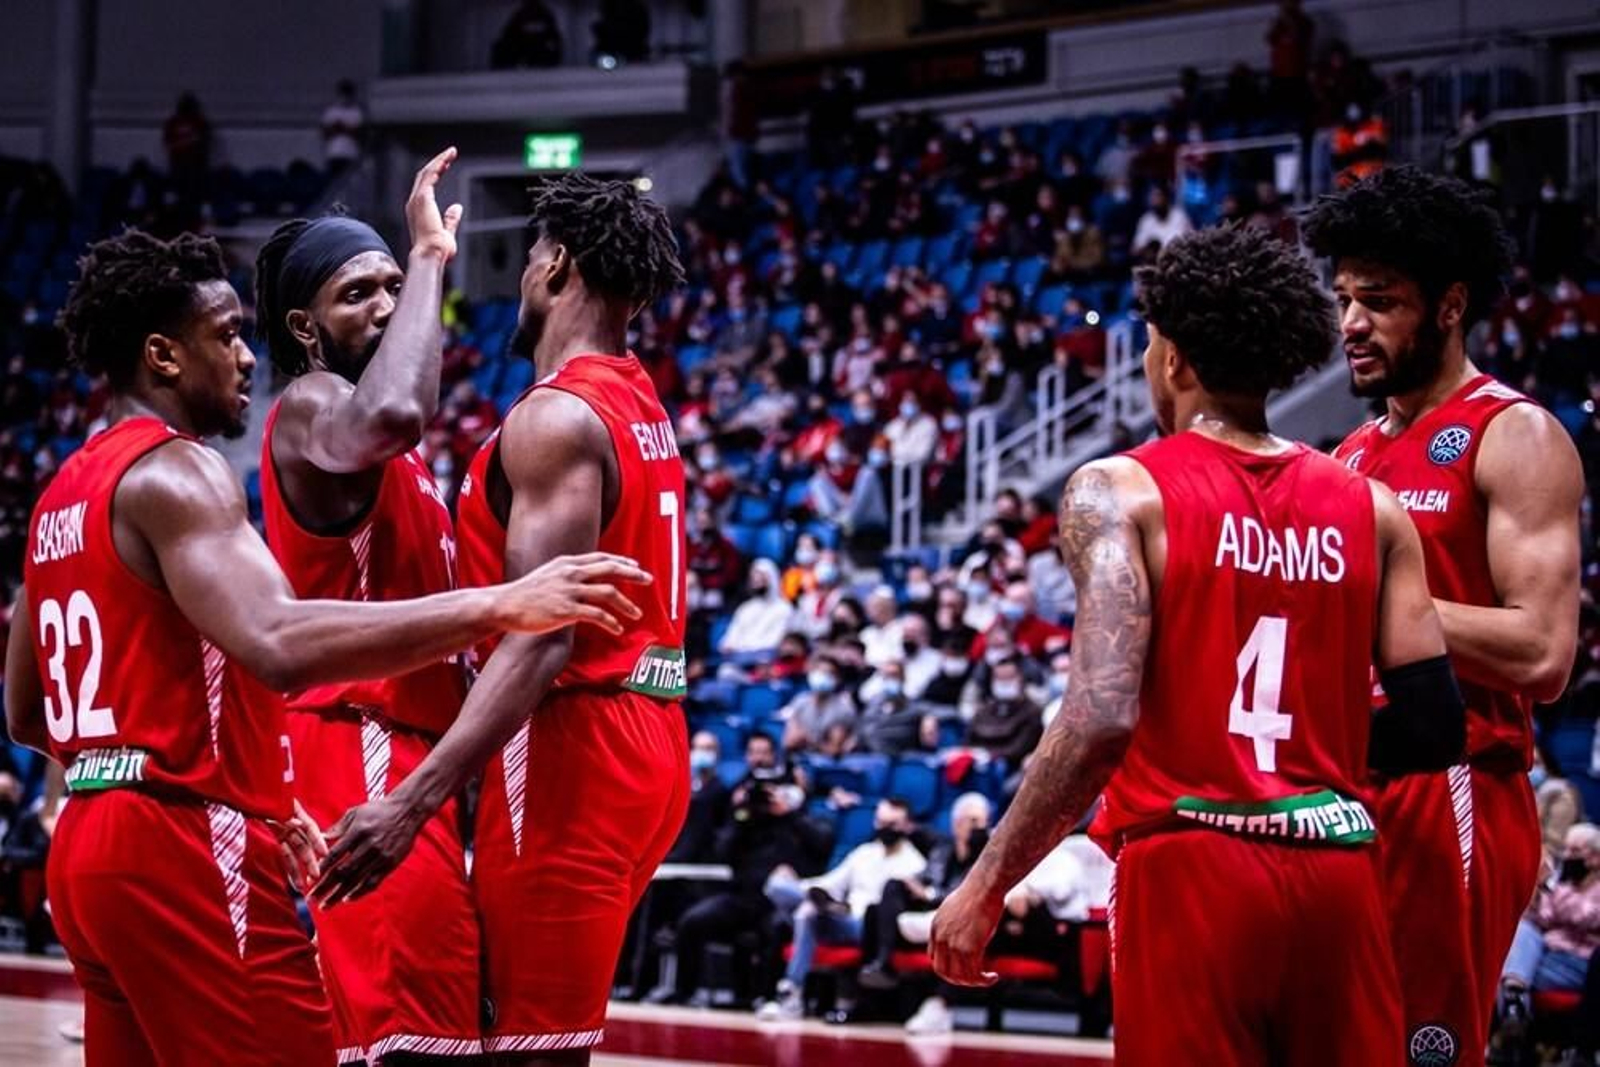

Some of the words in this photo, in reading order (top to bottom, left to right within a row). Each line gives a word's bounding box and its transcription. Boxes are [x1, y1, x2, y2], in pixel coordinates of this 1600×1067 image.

[1215, 512, 1345, 583] ADAMS
[1396, 490, 1450, 512] SALEM
[39, 590, 118, 743] 32
[1228, 615, 1293, 773] 4
